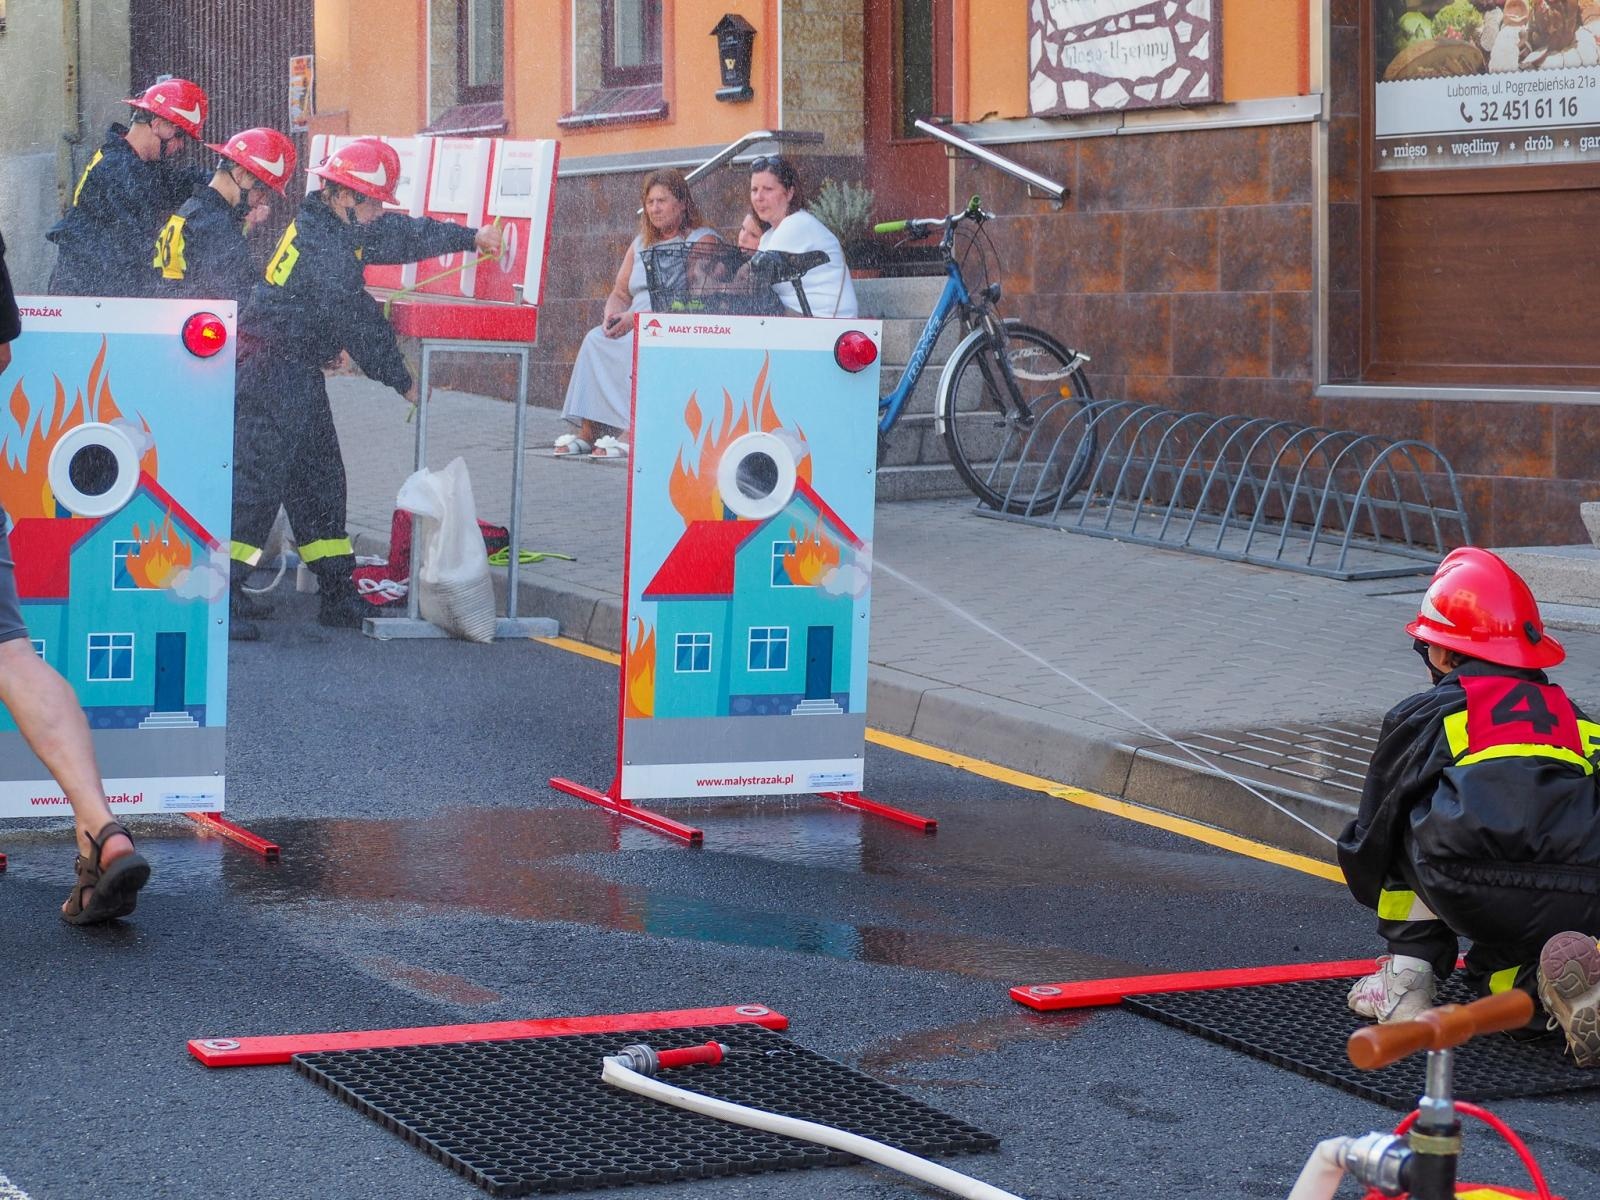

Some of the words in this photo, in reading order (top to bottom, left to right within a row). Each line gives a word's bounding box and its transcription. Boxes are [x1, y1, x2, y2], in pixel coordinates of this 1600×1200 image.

[1447, 82, 1490, 97] Lubomia,
[1492, 81, 1503, 95] ul.
[1505, 76, 1575, 96] Pogrzebieńska
[1577, 75, 1596, 89] 21a
[1480, 101, 1498, 122] 32
[1502, 99, 1529, 120] 451
[1535, 98, 1552, 119] 61
[1559, 96, 1578, 117] 16
[1394, 143, 1427, 160] mięso
[1451, 138, 1500, 157] wędliny
[1524, 135, 1554, 151] drób
[19, 306, 62, 317] STRAŻAK
[668, 325, 691, 334] MAŁY
[693, 324, 731, 335] STRAŻAK
[1490, 681, 1560, 735] 4
[696, 773, 794, 787] www.malystrazak.pl
